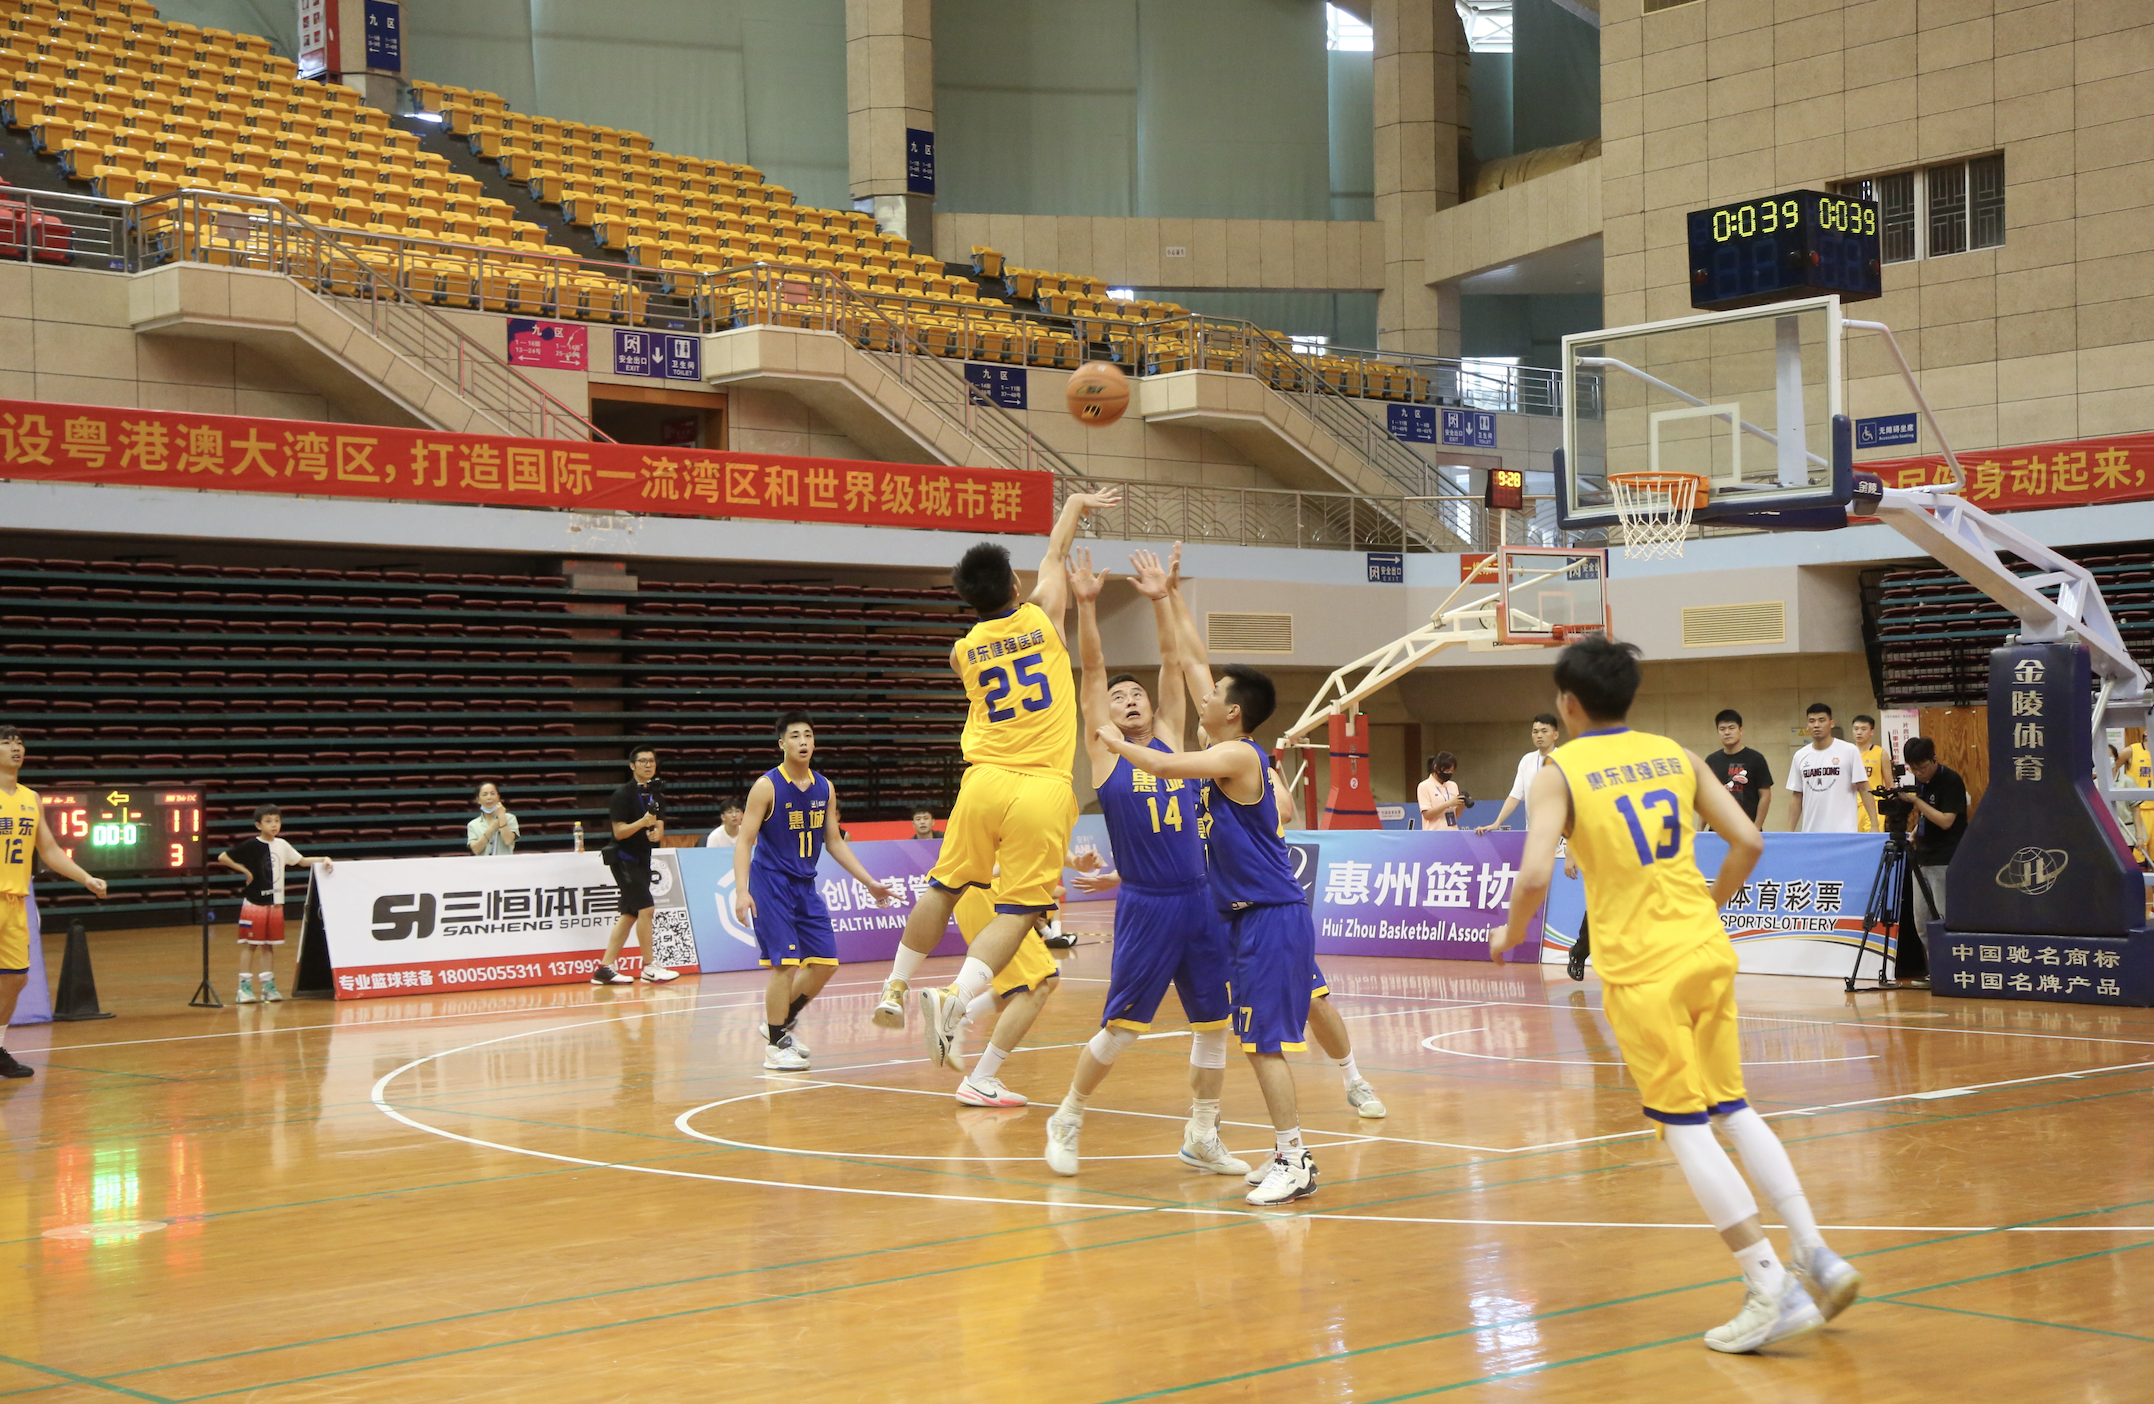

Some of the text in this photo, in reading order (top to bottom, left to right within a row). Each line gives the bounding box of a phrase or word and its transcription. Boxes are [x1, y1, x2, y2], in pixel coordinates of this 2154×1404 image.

[532, 324, 564, 338] 九区
[619, 355, 647, 365] 安全出口
[671, 360, 695, 370] 卫生间
[982, 369, 1008, 381] 九区
[1401, 408, 1421, 418] 九区
[1444, 429, 1463, 437] 安全出口
[1498, 470, 1521, 488] 9:28
[1872, 447, 2146, 501] 民健身动起来，
[1858, 480, 1877, 495] 金陵
[1381, 565, 1402, 576] 安全出口
[979, 652, 1053, 724] 25
[2012, 659, 2045, 782] 金陵体育
[1585, 757, 1684, 792] 惠东健强医院
[1802, 766, 1840, 778] GUANG DONG
[0, 817, 34, 836] 惠东
[60, 809, 88, 837] 15
[173, 808, 199, 833] 11
[788, 810, 826, 831] 惠城
[1147, 795, 1183, 833] 14
[1614, 788, 1682, 867] 13
[5, 838, 23, 864] 12
[170, 843, 184, 867] 3
[798, 831, 813, 858] 11
[1324, 860, 1520, 910] 惠州篮协
[441, 885, 622, 924] 三恒体育
[442, 915, 621, 937] SANHENG SPORTS
[831, 915, 874, 932] EALTH
[1322, 918, 1491, 943] Hui Zhou Basketball Associ
[1952, 943, 2121, 969] 中国驰名商标
[338, 956, 644, 992] 专业篮球装备 18005055311 1379921277
[1953, 970, 2121, 996] 中国名牌产品
